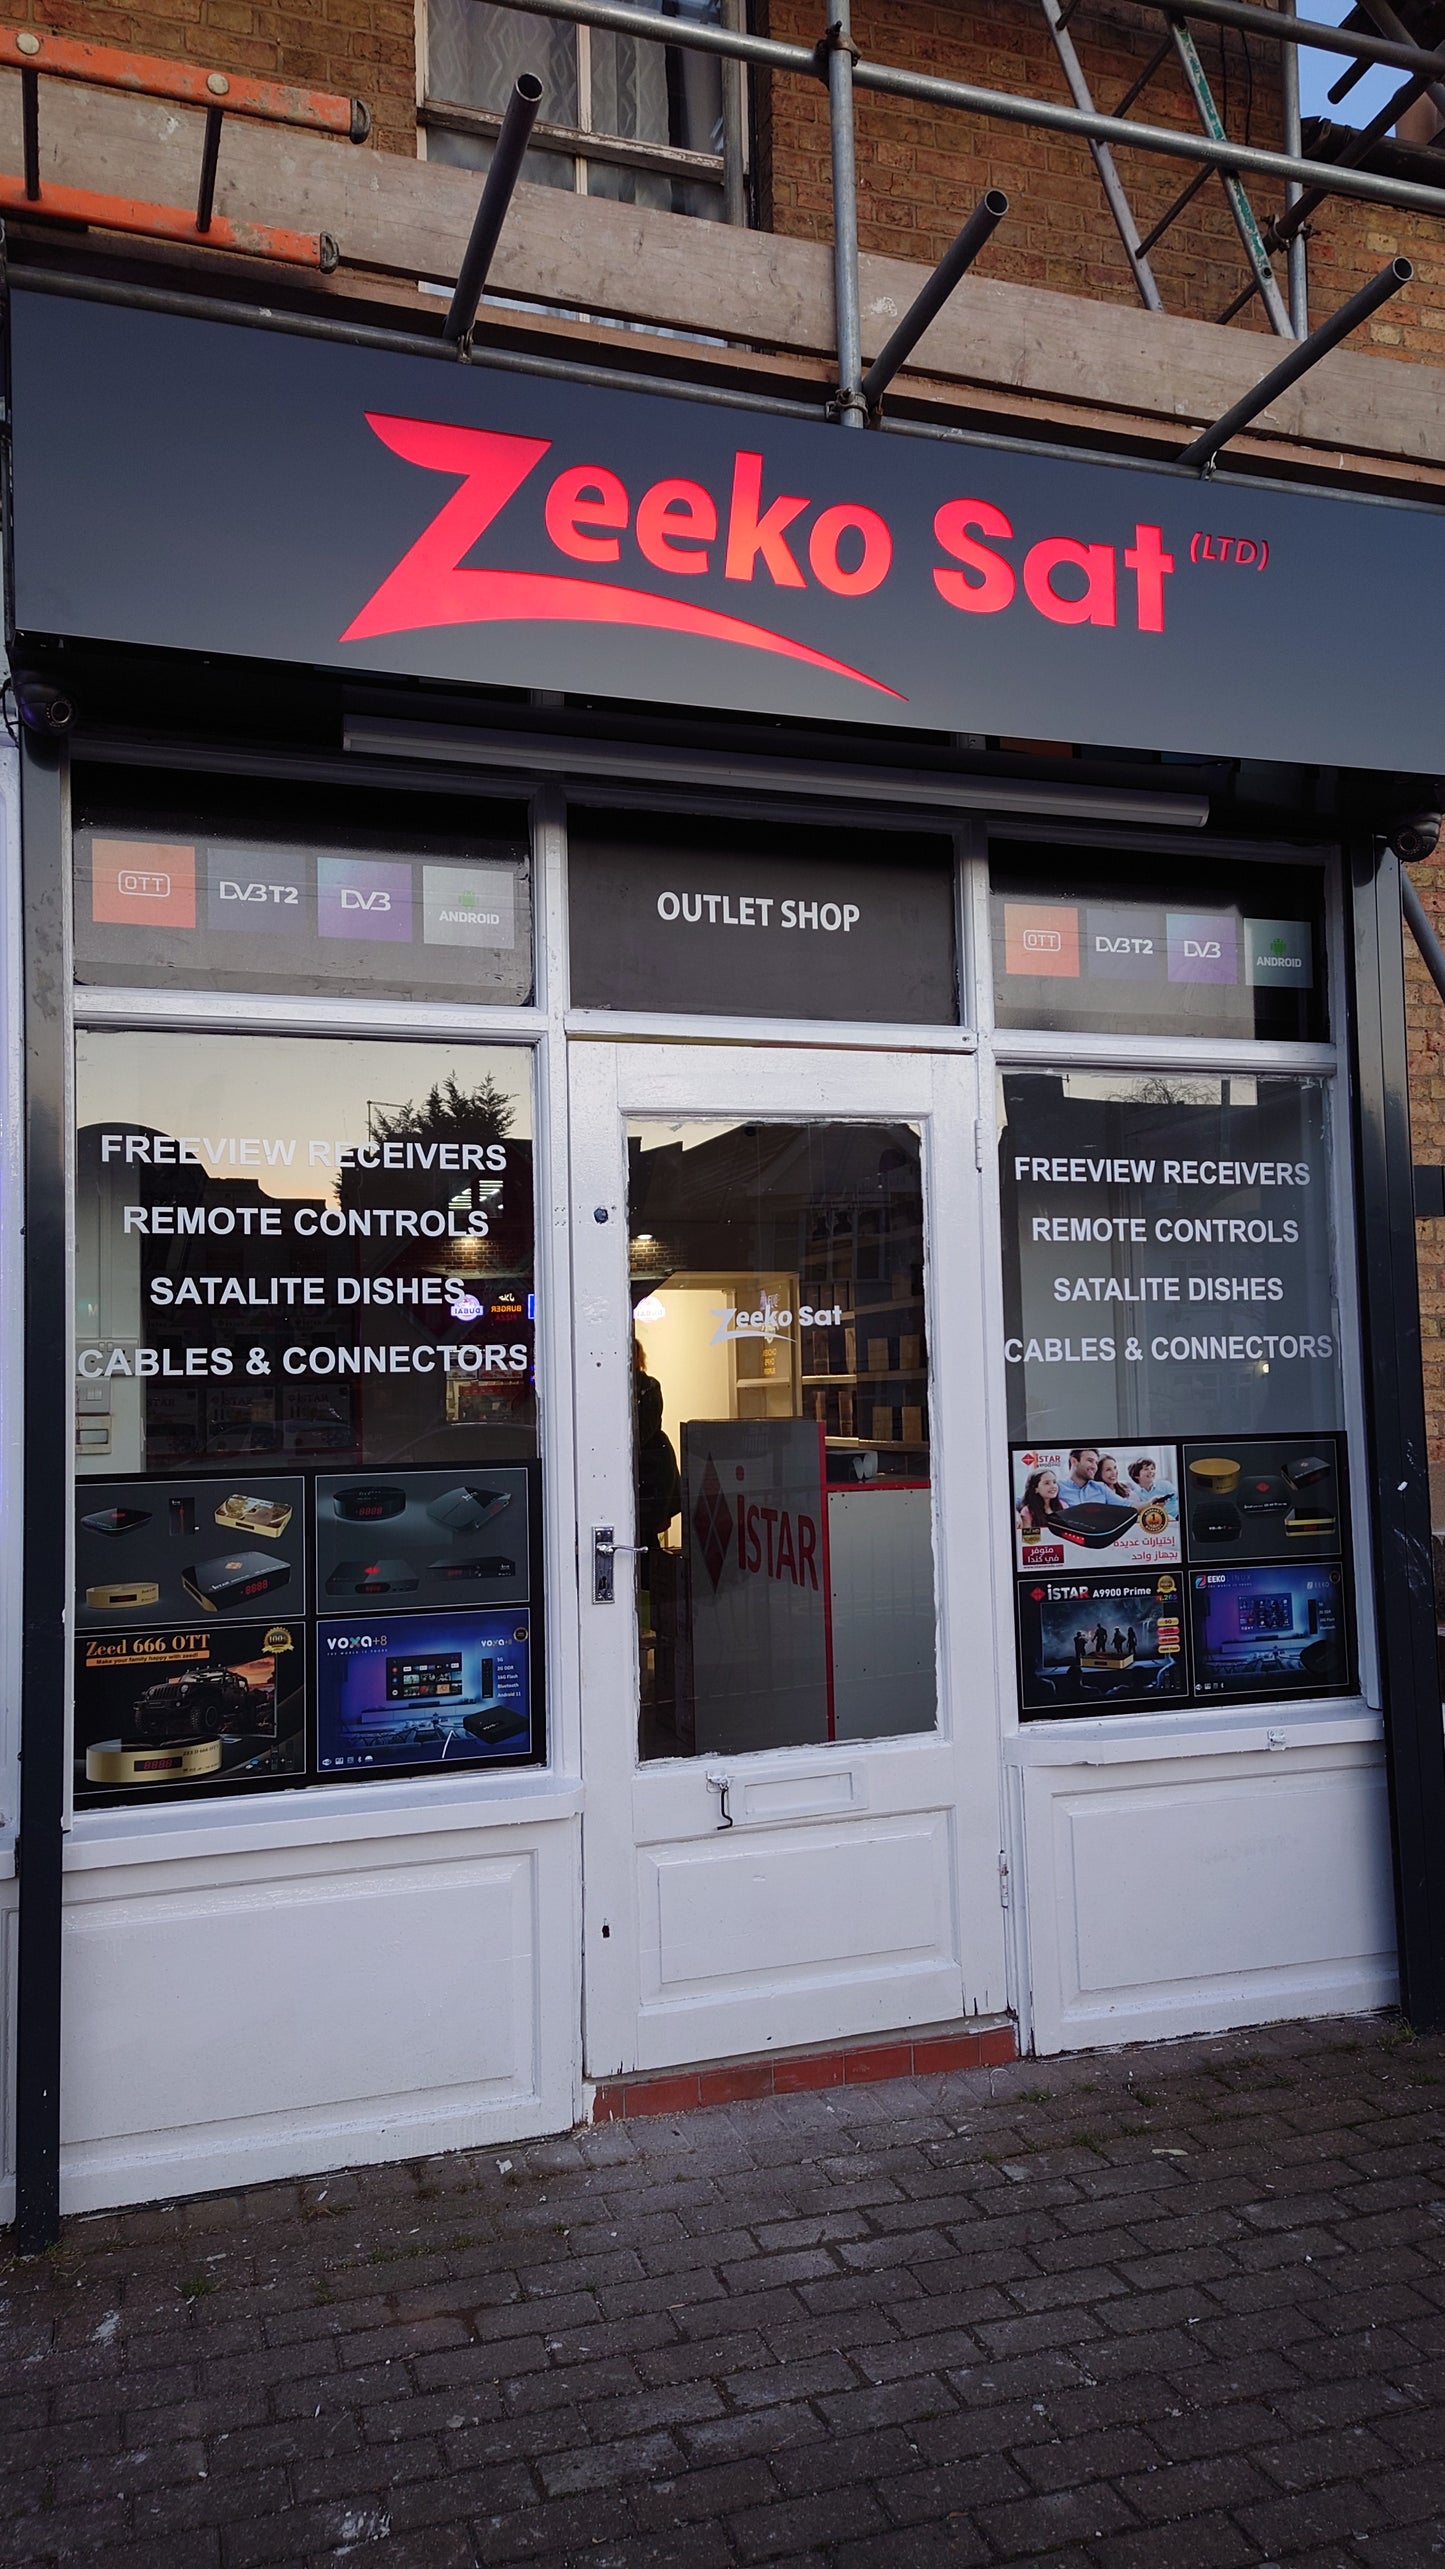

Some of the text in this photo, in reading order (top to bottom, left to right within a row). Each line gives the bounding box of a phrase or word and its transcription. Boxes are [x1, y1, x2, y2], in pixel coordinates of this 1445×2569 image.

[340, 411, 1270, 700] Zeeko Sat (LTD)
[125, 876, 164, 892] OTT
[439, 911, 500, 925] ANDROID
[657, 891, 860, 932] OUTLET SHOP
[1028, 934, 1056, 947] OTT
[1256, 957, 1301, 967] ANDROID
[101, 1134, 507, 1171] FREEVIEW RECEIVERS
[1014, 1157, 1310, 1186] FREEVIEW RECEIVERS
[123, 1206, 489, 1238] REMOTE CONTROLS
[1032, 1218, 1299, 1244] REMOTE CONTROLS
[150, 1277, 465, 1305] SATALITE DISHES
[1053, 1277, 1283, 1302] SATALITE DISHES
[710, 1304, 842, 1346] Zeeko Sat
[78, 1344, 528, 1378] CABLES & CONNECTORS
[1004, 1335, 1333, 1363] CABLES & CONNECTORS
[1092, 1589, 1122, 1599] A9900
[1123, 1587, 1152, 1597] Prime
[86, 1634, 210, 1657] Zeed 666 OTT
